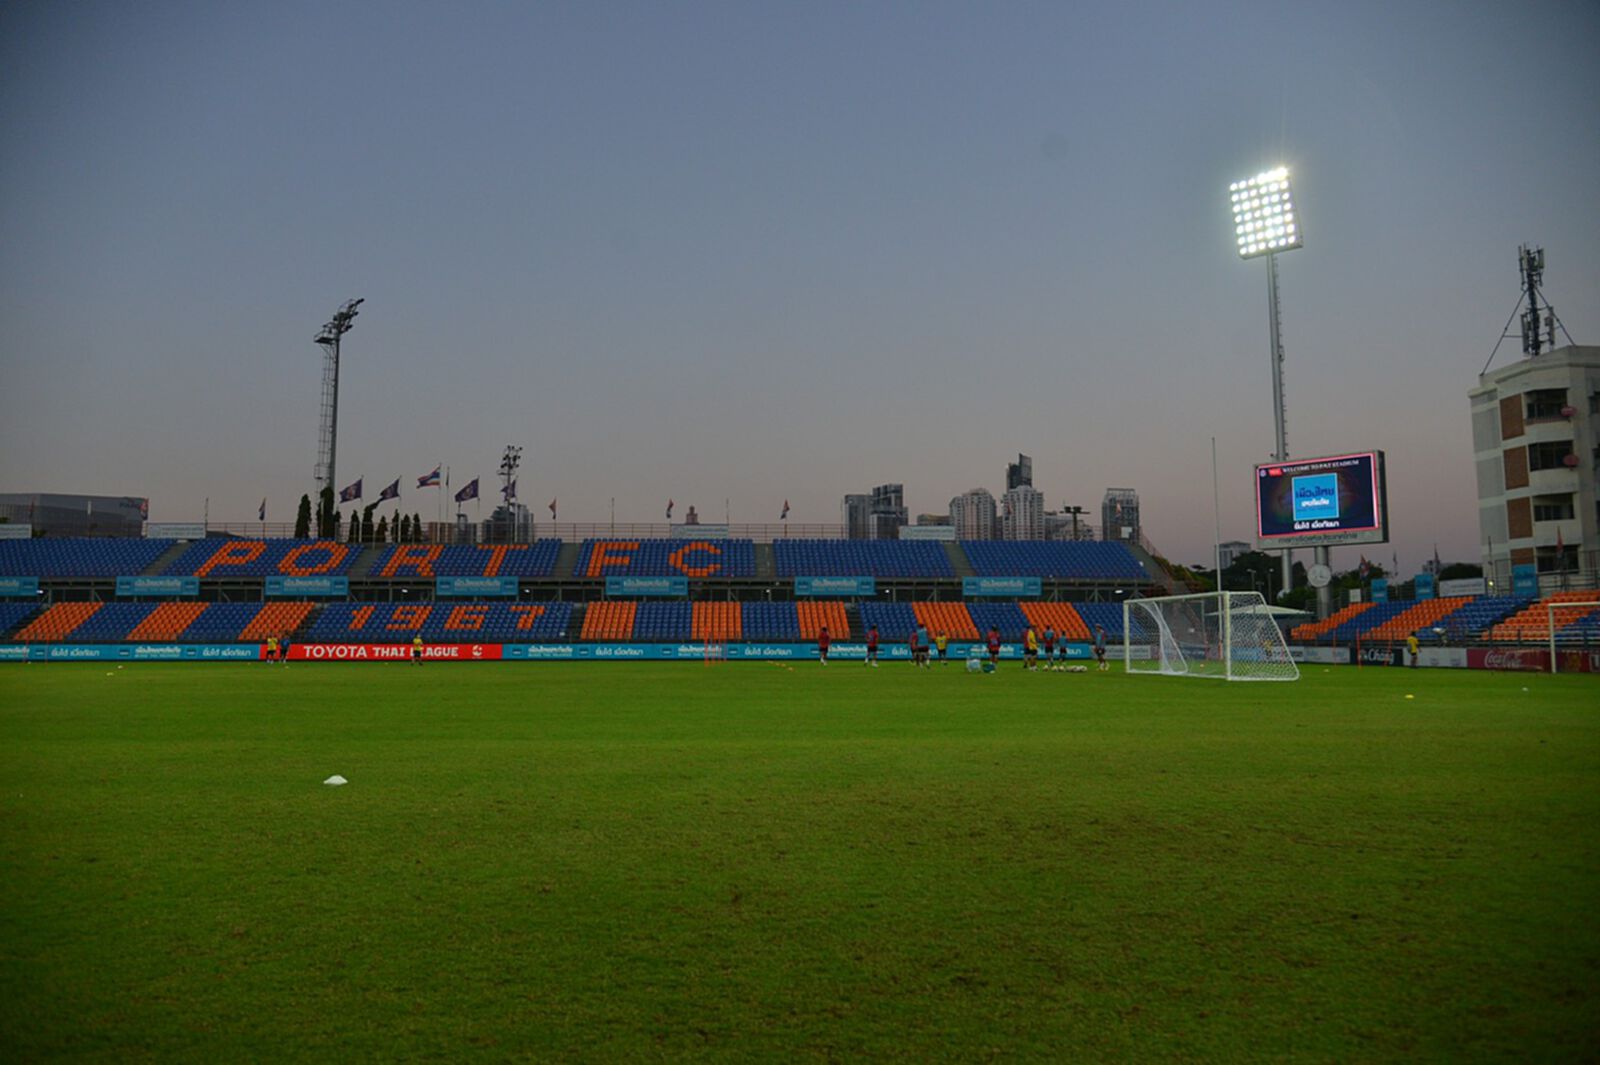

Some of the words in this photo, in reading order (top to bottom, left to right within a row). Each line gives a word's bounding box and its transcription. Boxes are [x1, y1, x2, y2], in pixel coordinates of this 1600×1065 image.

[349, 605, 545, 630] 1967
[303, 645, 367, 658] TOYOTA
[372, 647, 405, 657] THAI
[410, 646, 459, 658] LAGUE
